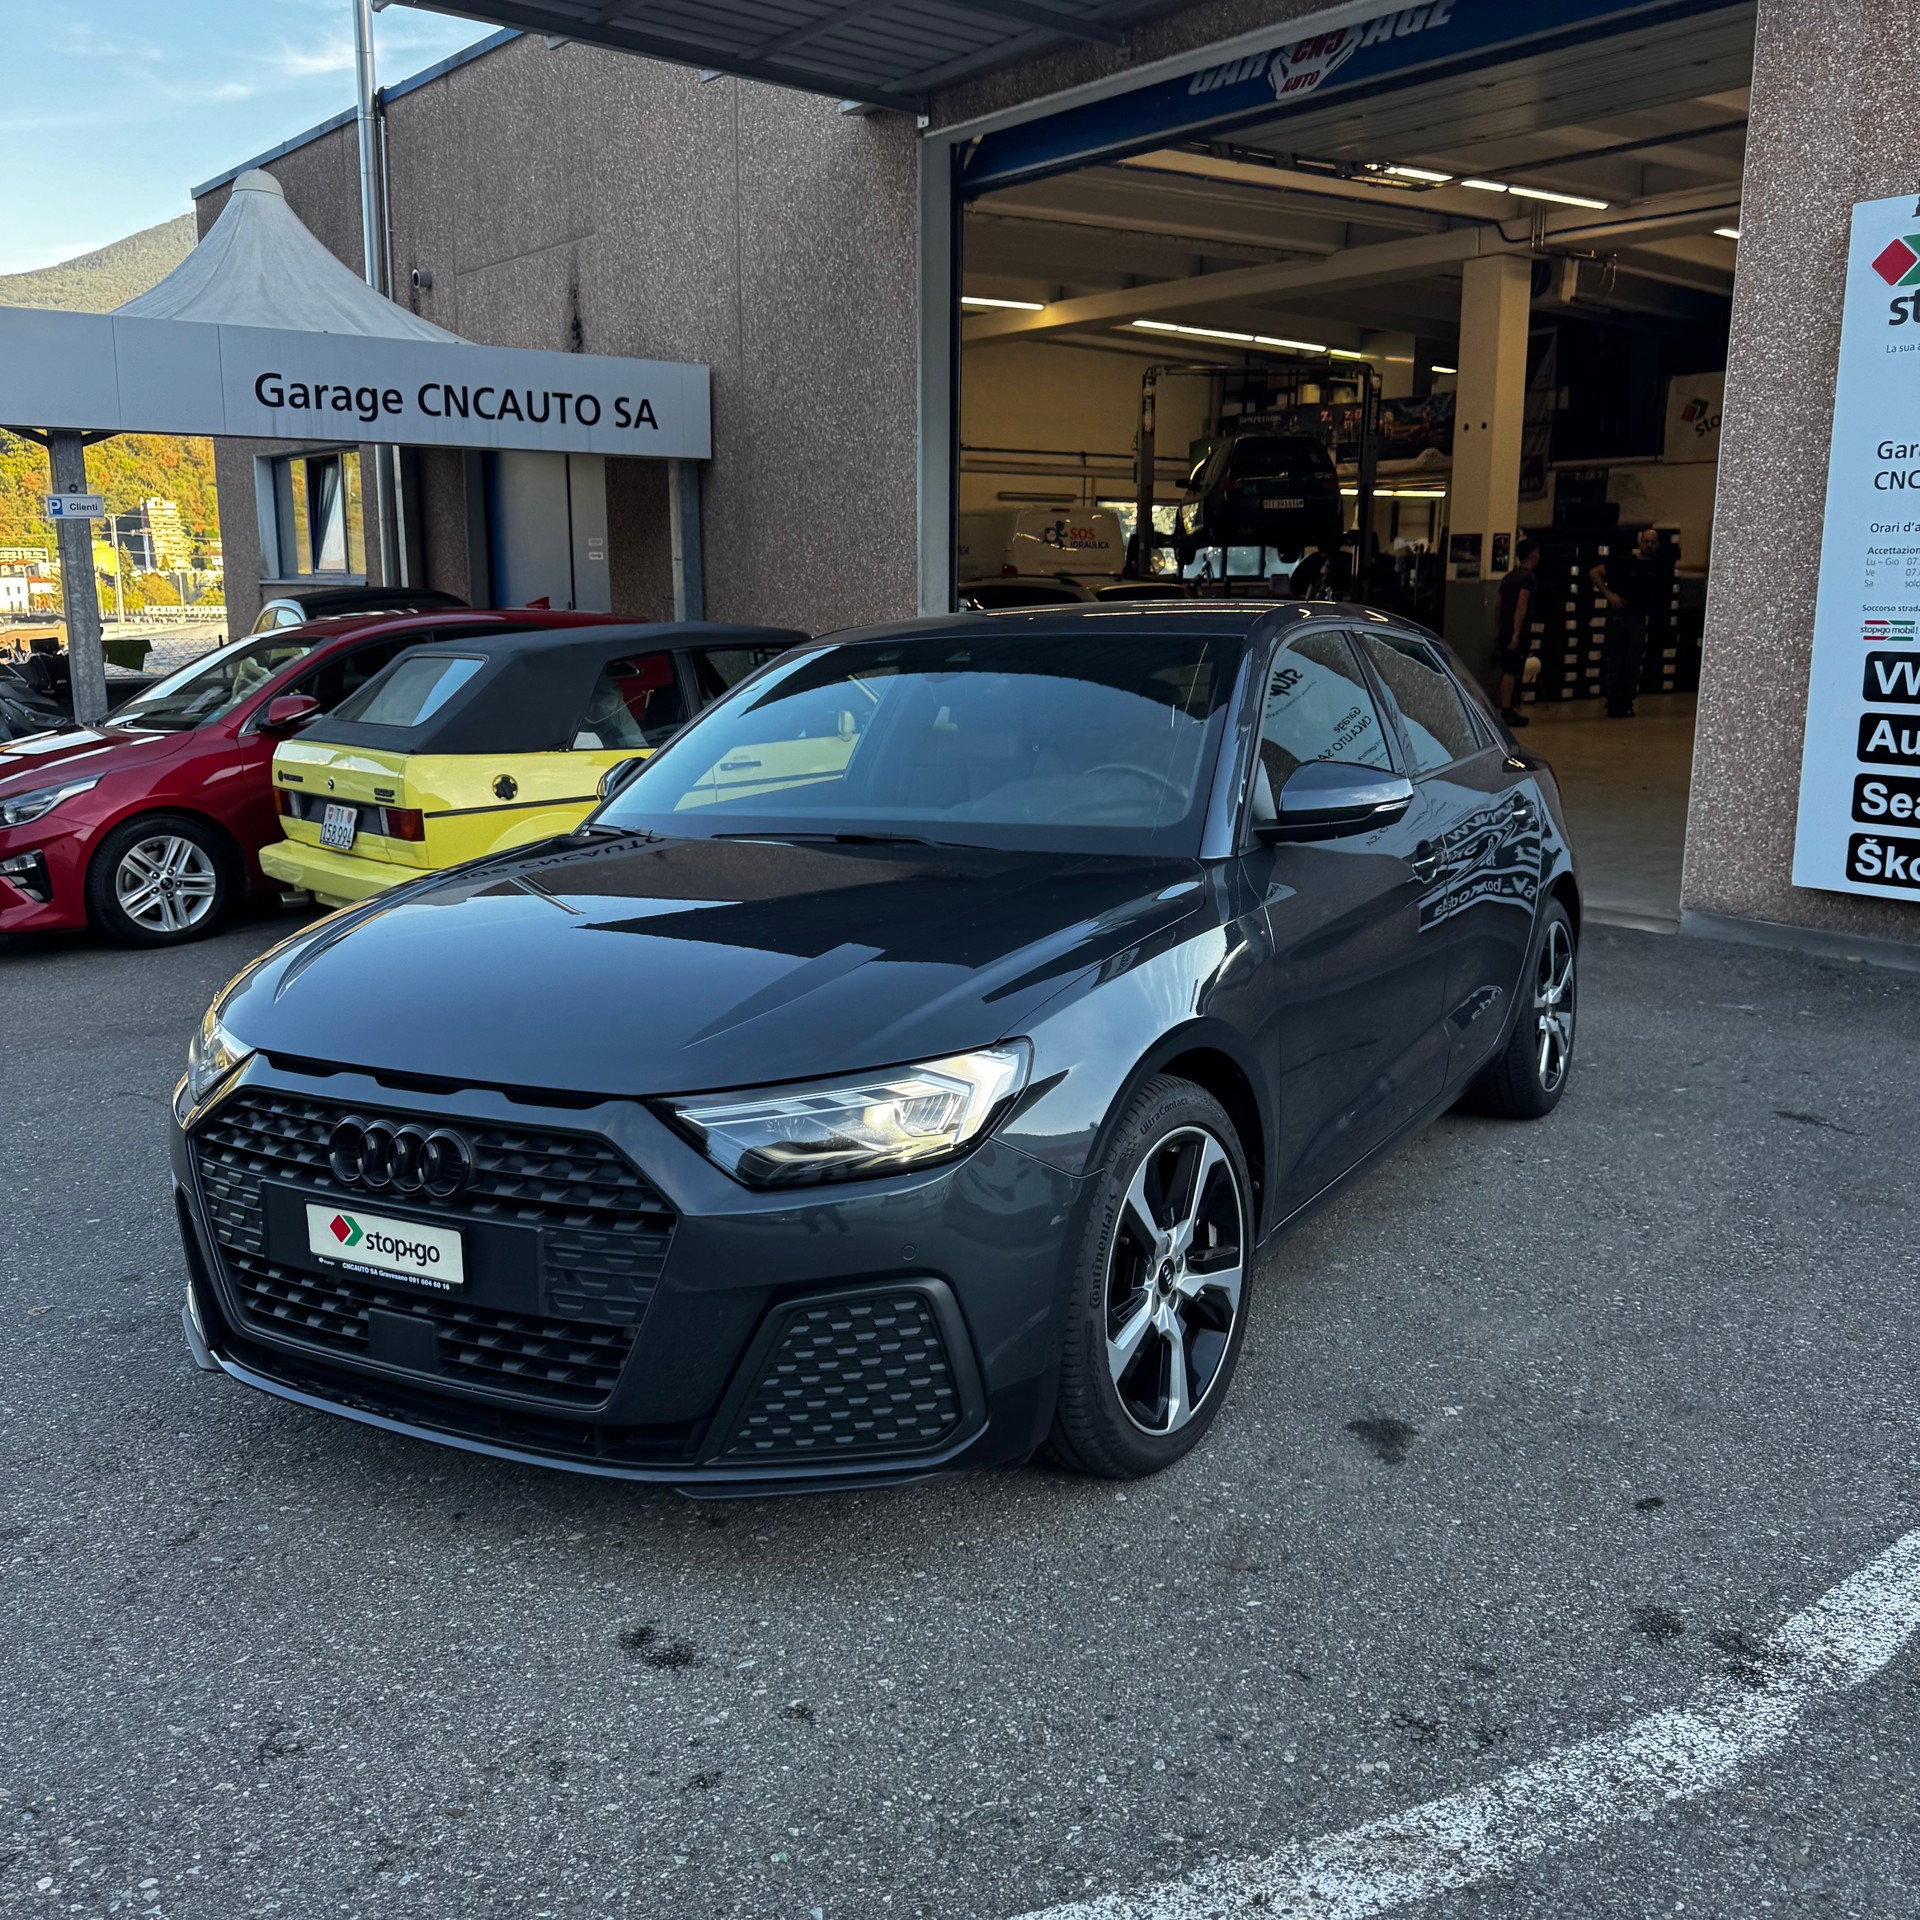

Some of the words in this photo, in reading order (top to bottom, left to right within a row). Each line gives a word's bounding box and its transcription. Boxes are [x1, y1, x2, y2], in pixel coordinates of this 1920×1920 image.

[1280, 69, 1321, 94] AUTO
[1886, 344, 1897, 354] La
[1898, 343, 1915, 353] sua
[254, 372, 404, 423] Garage
[417, 382, 602, 426] CNCAUTO
[613, 396, 659, 430] SA
[1877, 440, 1920, 460] Gar
[1873, 469, 1920, 491] CNC
[69, 502, 98, 511] Clienti
[1070, 527, 1096, 541] SOS
[1870, 521, 1900, 533] Orari
[1070, 540, 1110, 549] IDRAULICA
[1866, 557, 1876, 566] Lu
[1885, 557, 1900, 566] Gio
[1865, 568, 1876, 577] Ve
[1864, 578, 1874, 588] Sa
[1862, 603, 1897, 612] Soccorso
[1897, 604, 1920, 613] strad
[1865, 719, 1920, 755] Au
[1860, 781, 1920, 820] Se
[337, 808, 345, 823] TI
[1140, 1097, 1189, 1136] UltraContact
[365, 1231, 440, 1267] stop+go
[1089, 1205, 1114, 1309] Continental
[342, 1262, 370, 1274] CNCAUTO
[369, 1267, 379, 1276] SA
